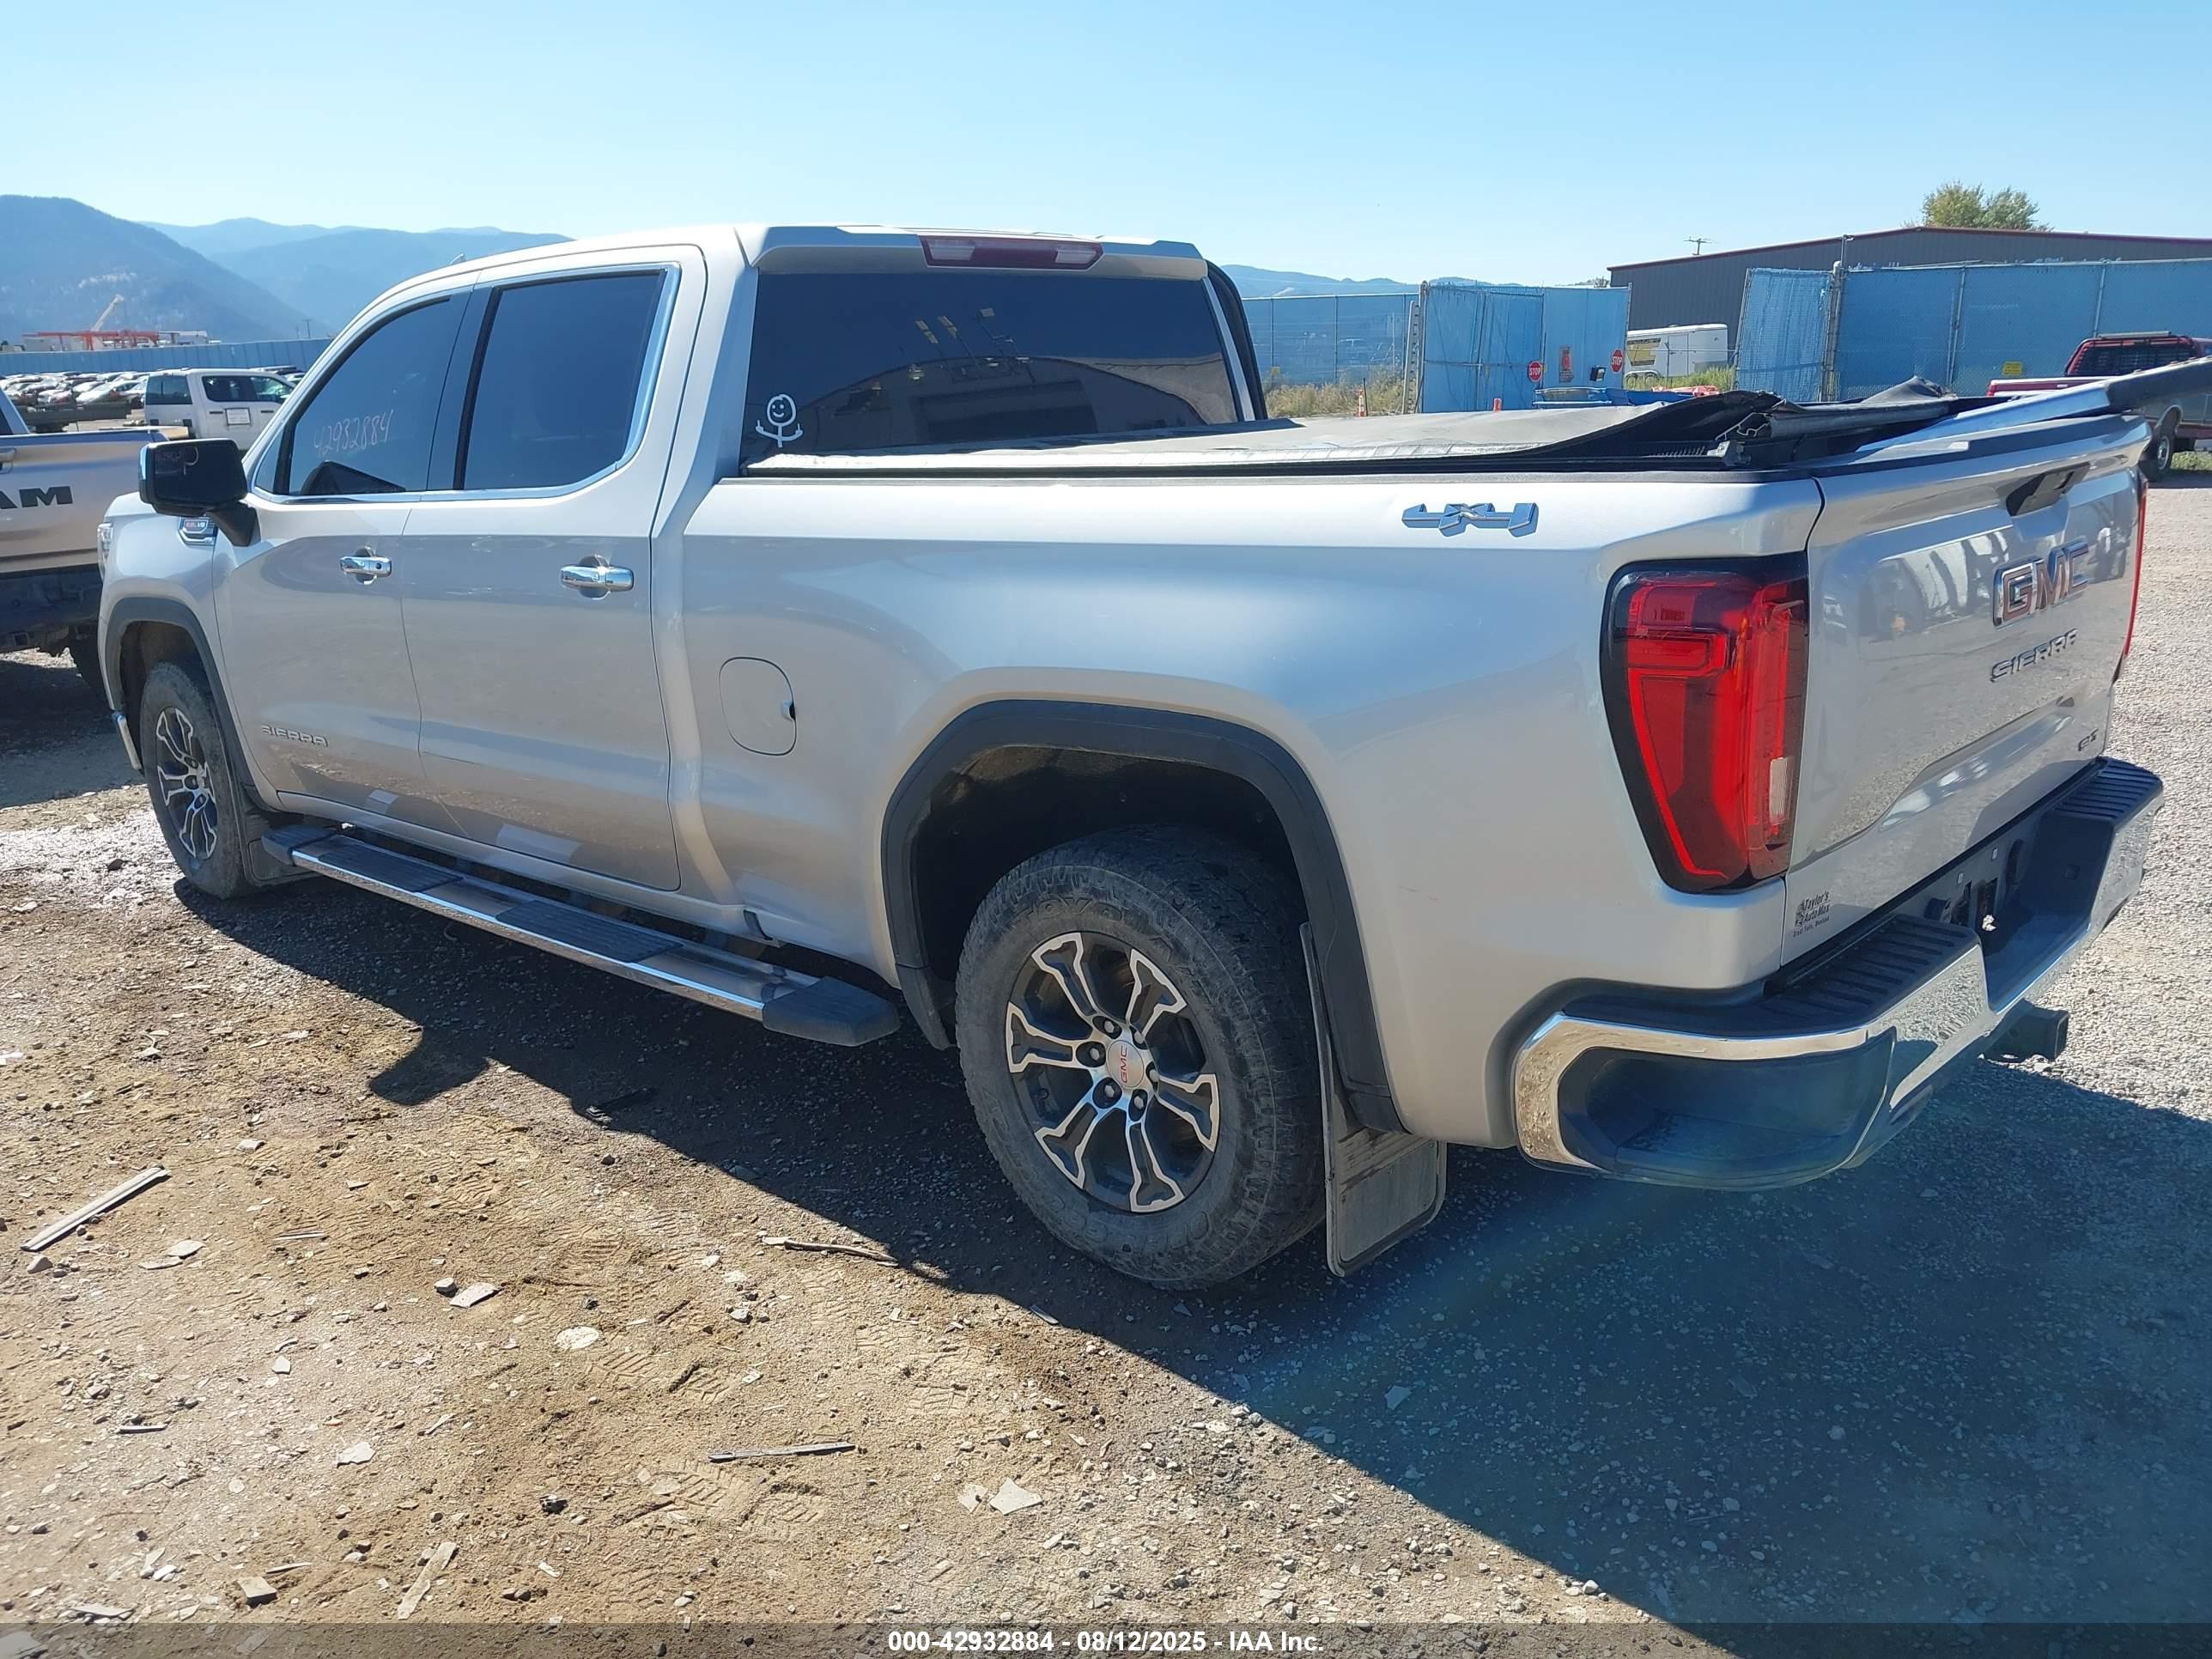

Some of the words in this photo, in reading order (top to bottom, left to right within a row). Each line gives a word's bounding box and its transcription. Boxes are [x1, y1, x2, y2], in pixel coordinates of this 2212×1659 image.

[1529, 367, 1540, 376] STOP
[1612, 356, 1623, 366] STOP
[1993, 540, 2088, 626] GMC
[1990, 628, 2080, 683] SIERRA
[260, 725, 328, 747] SIERRA
[1804, 891, 1830, 911] Taylor's
[1120, 1044, 1128, 1084] GMC
